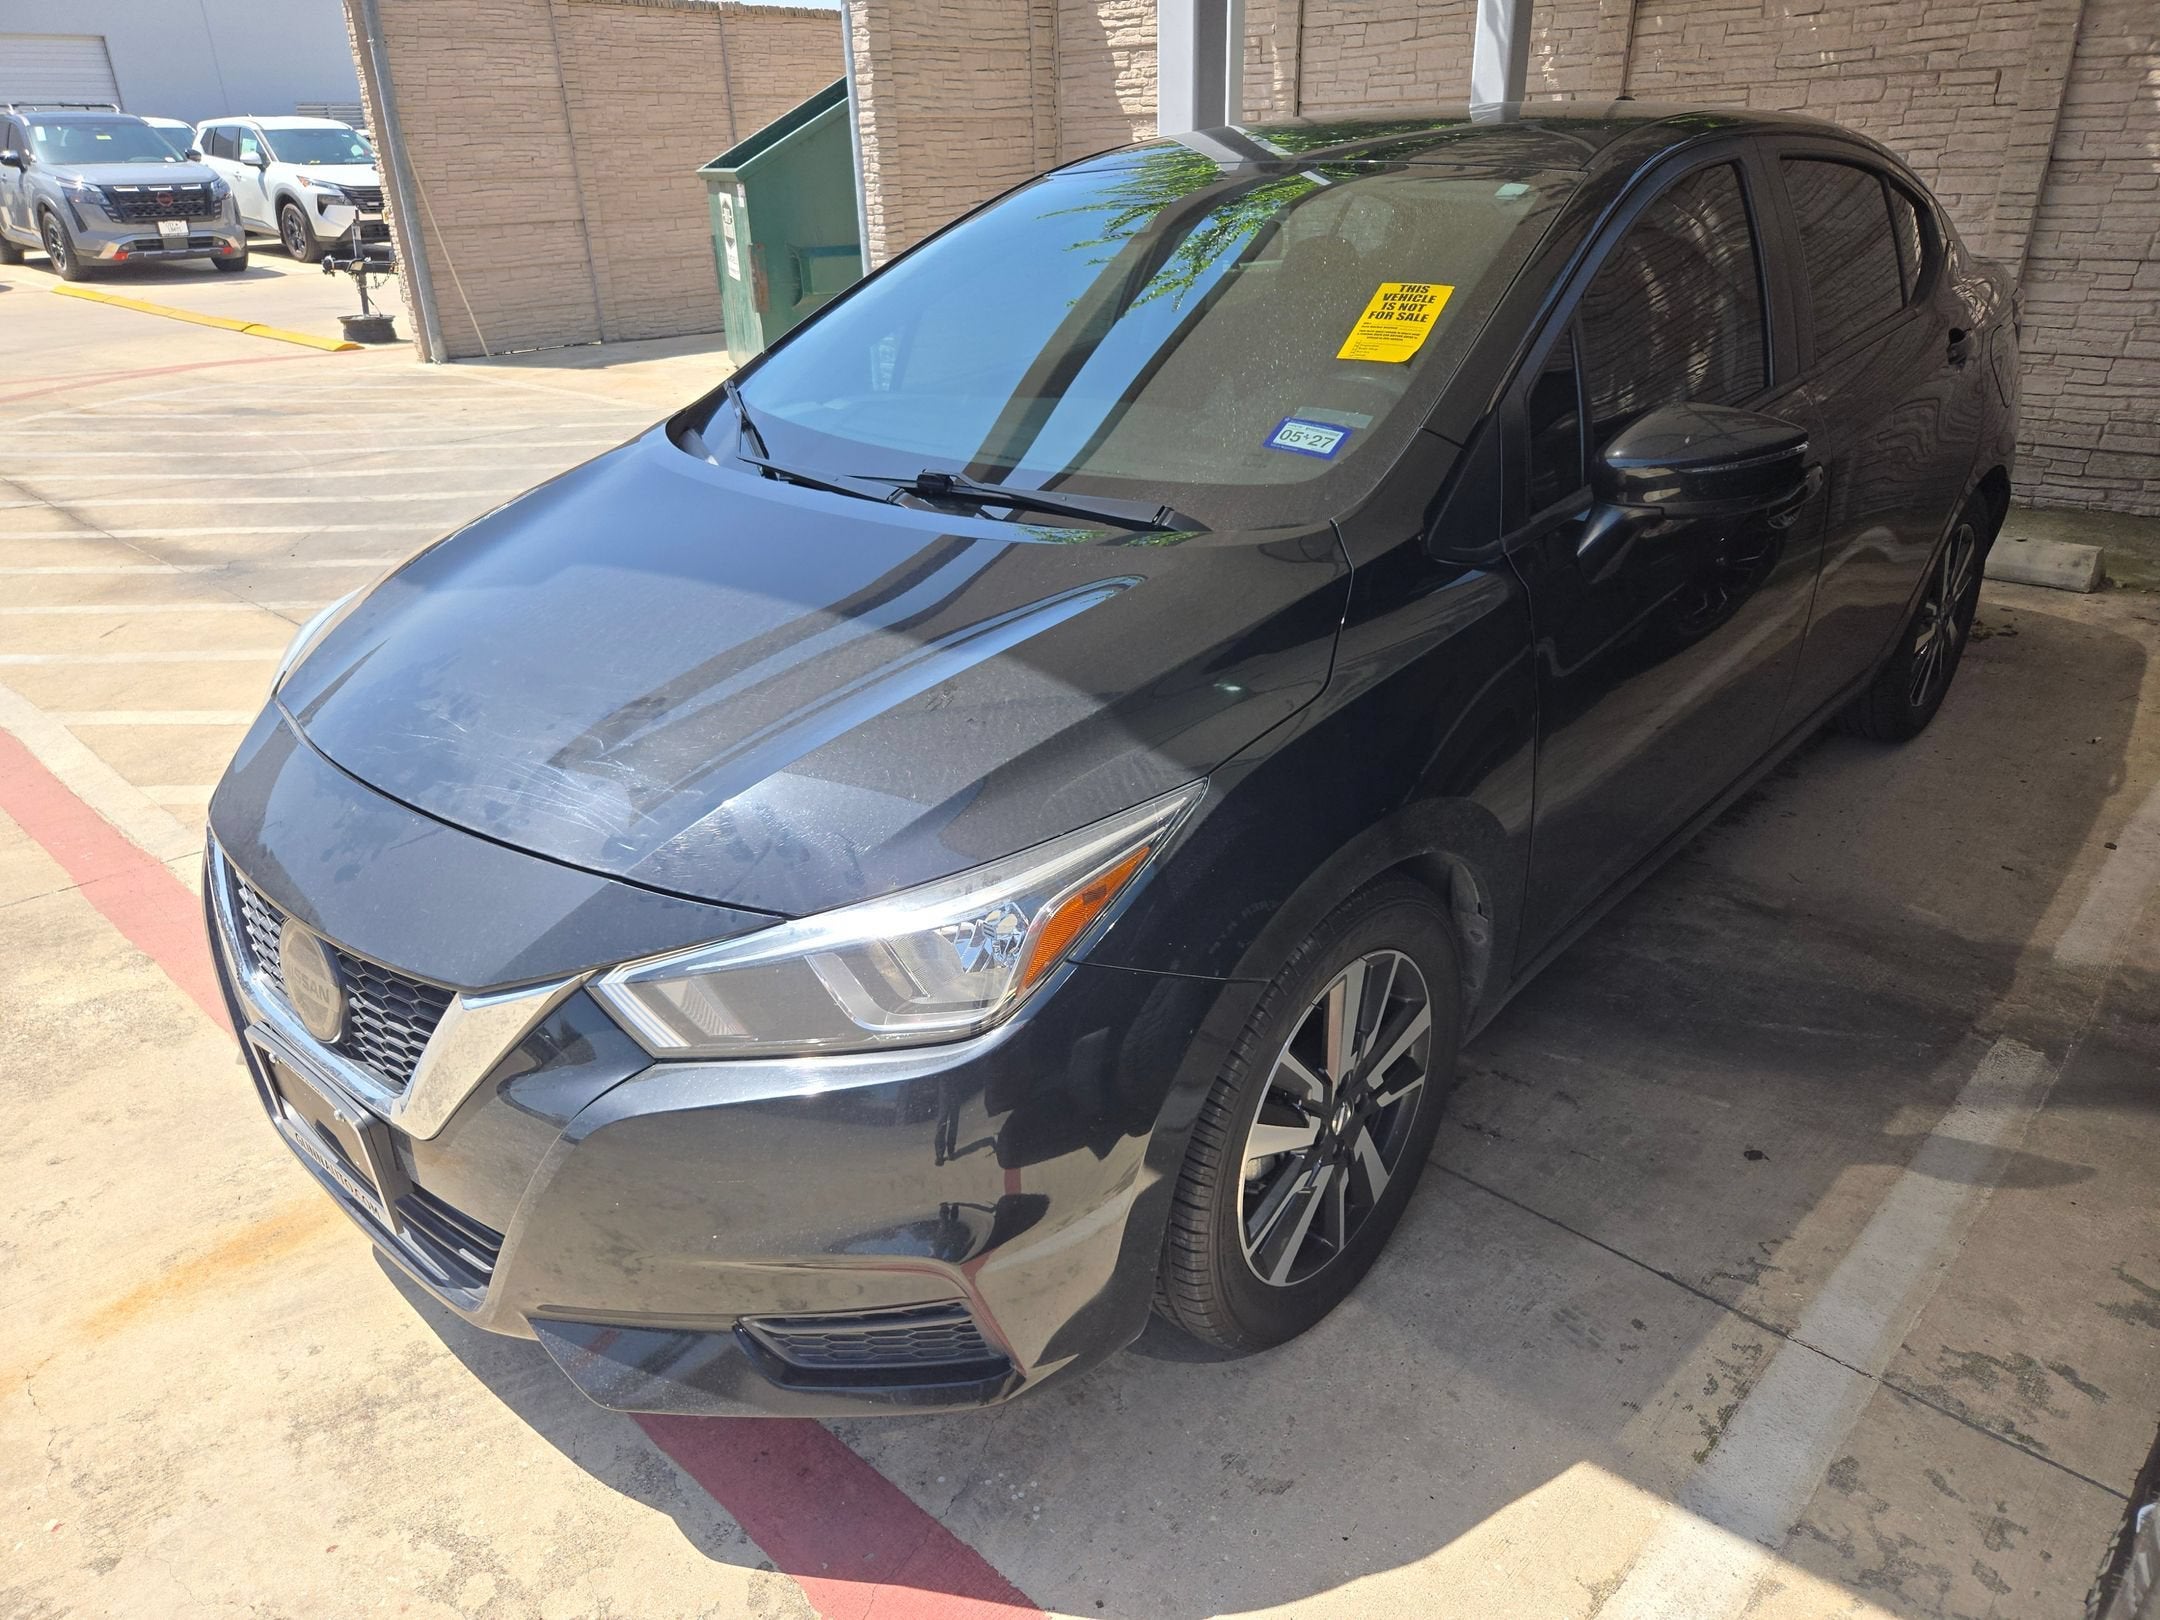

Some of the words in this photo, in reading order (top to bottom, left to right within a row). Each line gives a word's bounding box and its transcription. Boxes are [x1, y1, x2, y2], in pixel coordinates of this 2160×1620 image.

[1400, 285, 1431, 294] THIS
[1383, 293, 1437, 304] VEHICLE
[1381, 302, 1397, 311] IS
[1398, 303, 1427, 312] NOT
[1368, 311, 1395, 320] FOR
[1397, 312, 1430, 323] SALE
[287, 964, 330, 1004] NISSAN
